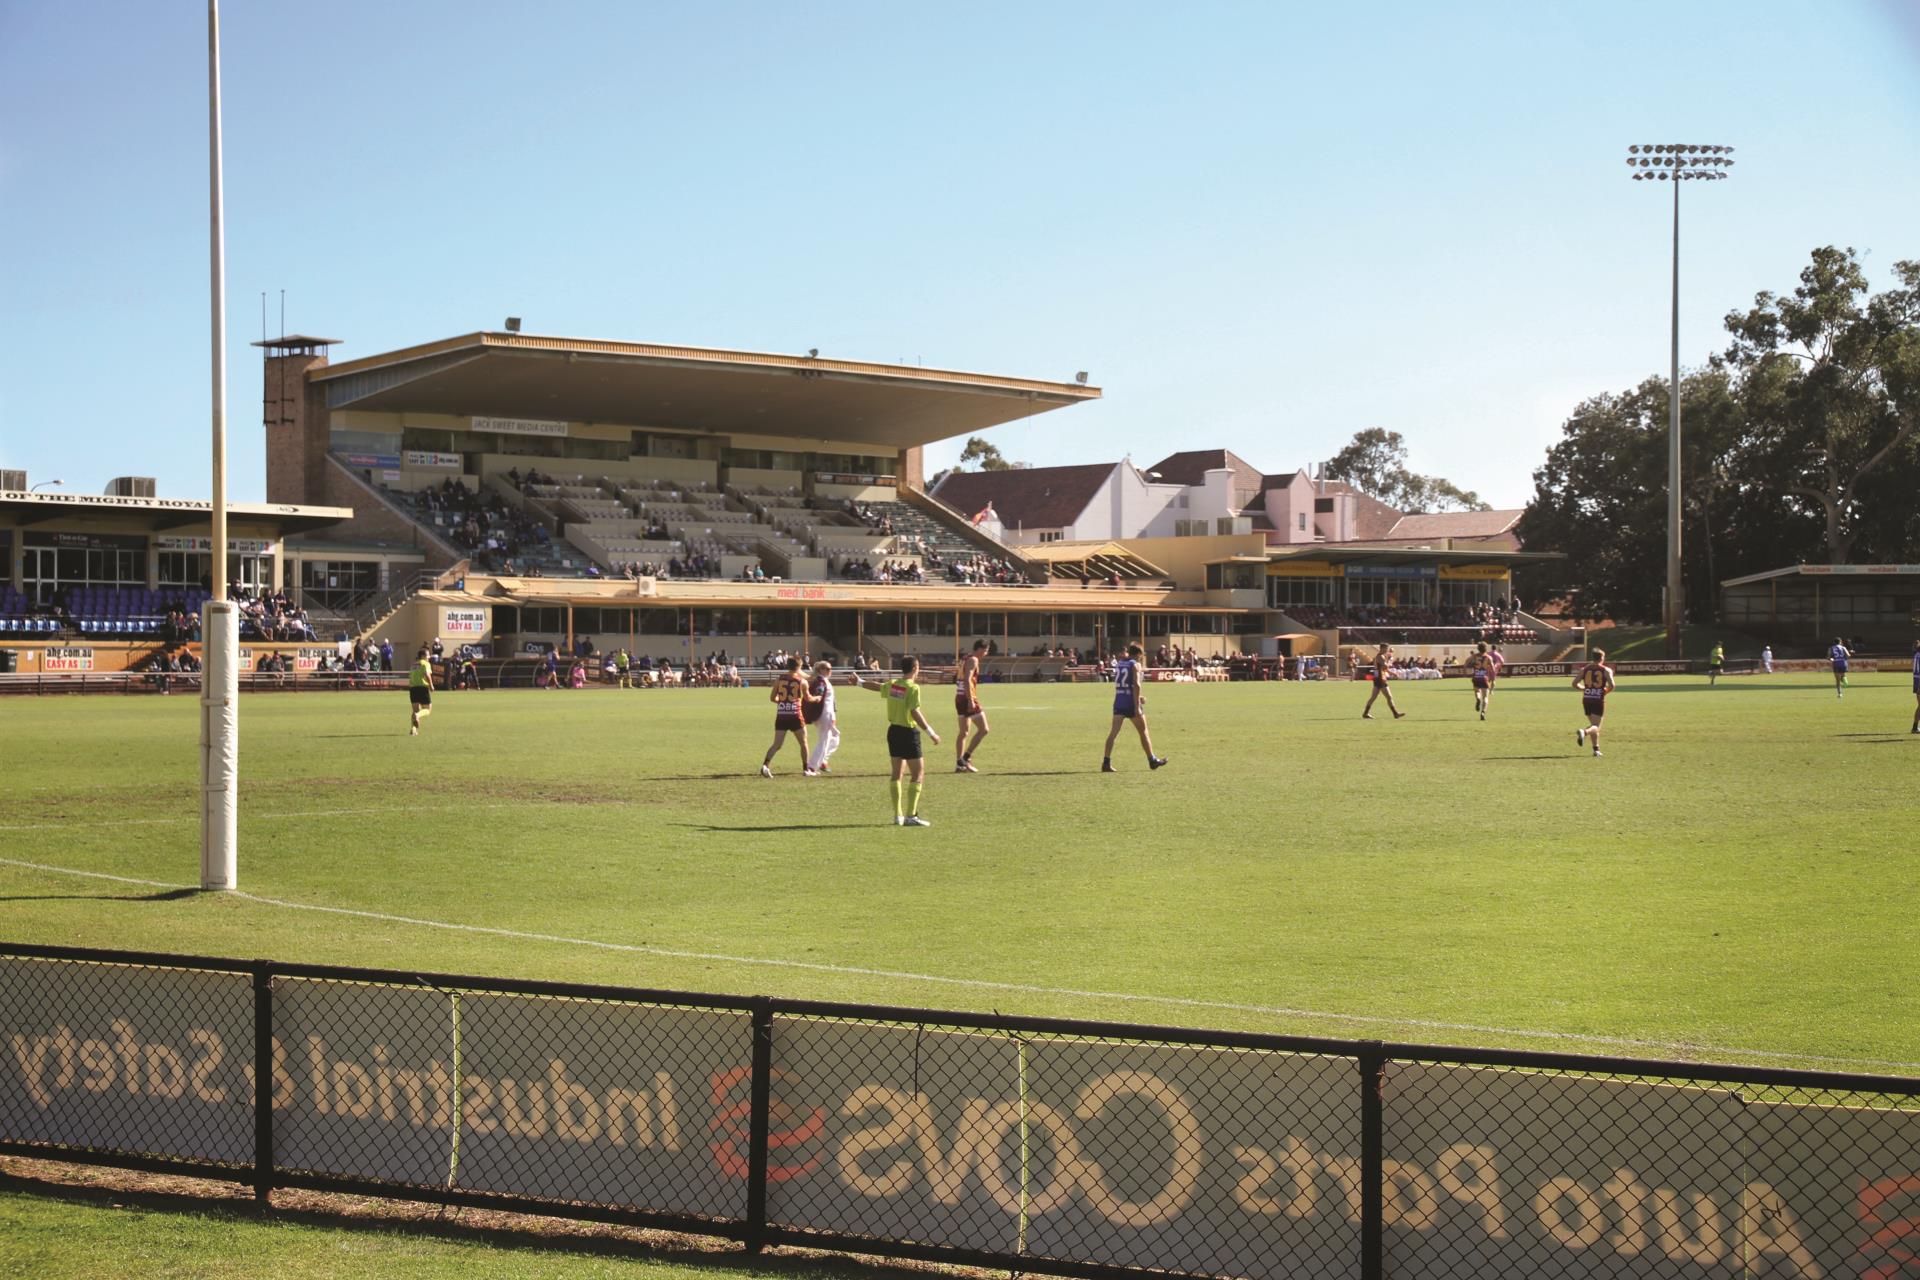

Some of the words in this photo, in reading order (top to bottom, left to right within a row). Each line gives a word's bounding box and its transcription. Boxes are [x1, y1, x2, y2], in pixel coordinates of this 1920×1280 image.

[474, 419, 490, 429] JACK
[491, 420, 516, 431] SWEET
[517, 422, 538, 432] MEDIA
[540, 424, 566, 434] CENTRE
[35, 494, 75, 502] THE
[79, 496, 154, 506] MIGHTY
[159, 500, 212, 508] ROYAL
[447, 611, 483, 622] ahg.com.au
[447, 622, 462, 630] EASY
[464, 622, 472, 630] AS
[46, 648, 92, 659] ahg.com.au
[46, 659, 66, 668] EASY
[68, 659, 78, 668] AS
[79, 659, 92, 668] 123
[299, 659, 316, 668] EASY
[1512, 665, 1565, 674] #GOSUBI
[1115, 668, 1129, 688] 22
[1584, 671, 1603, 688] 43
[778, 680, 800, 701] 53
